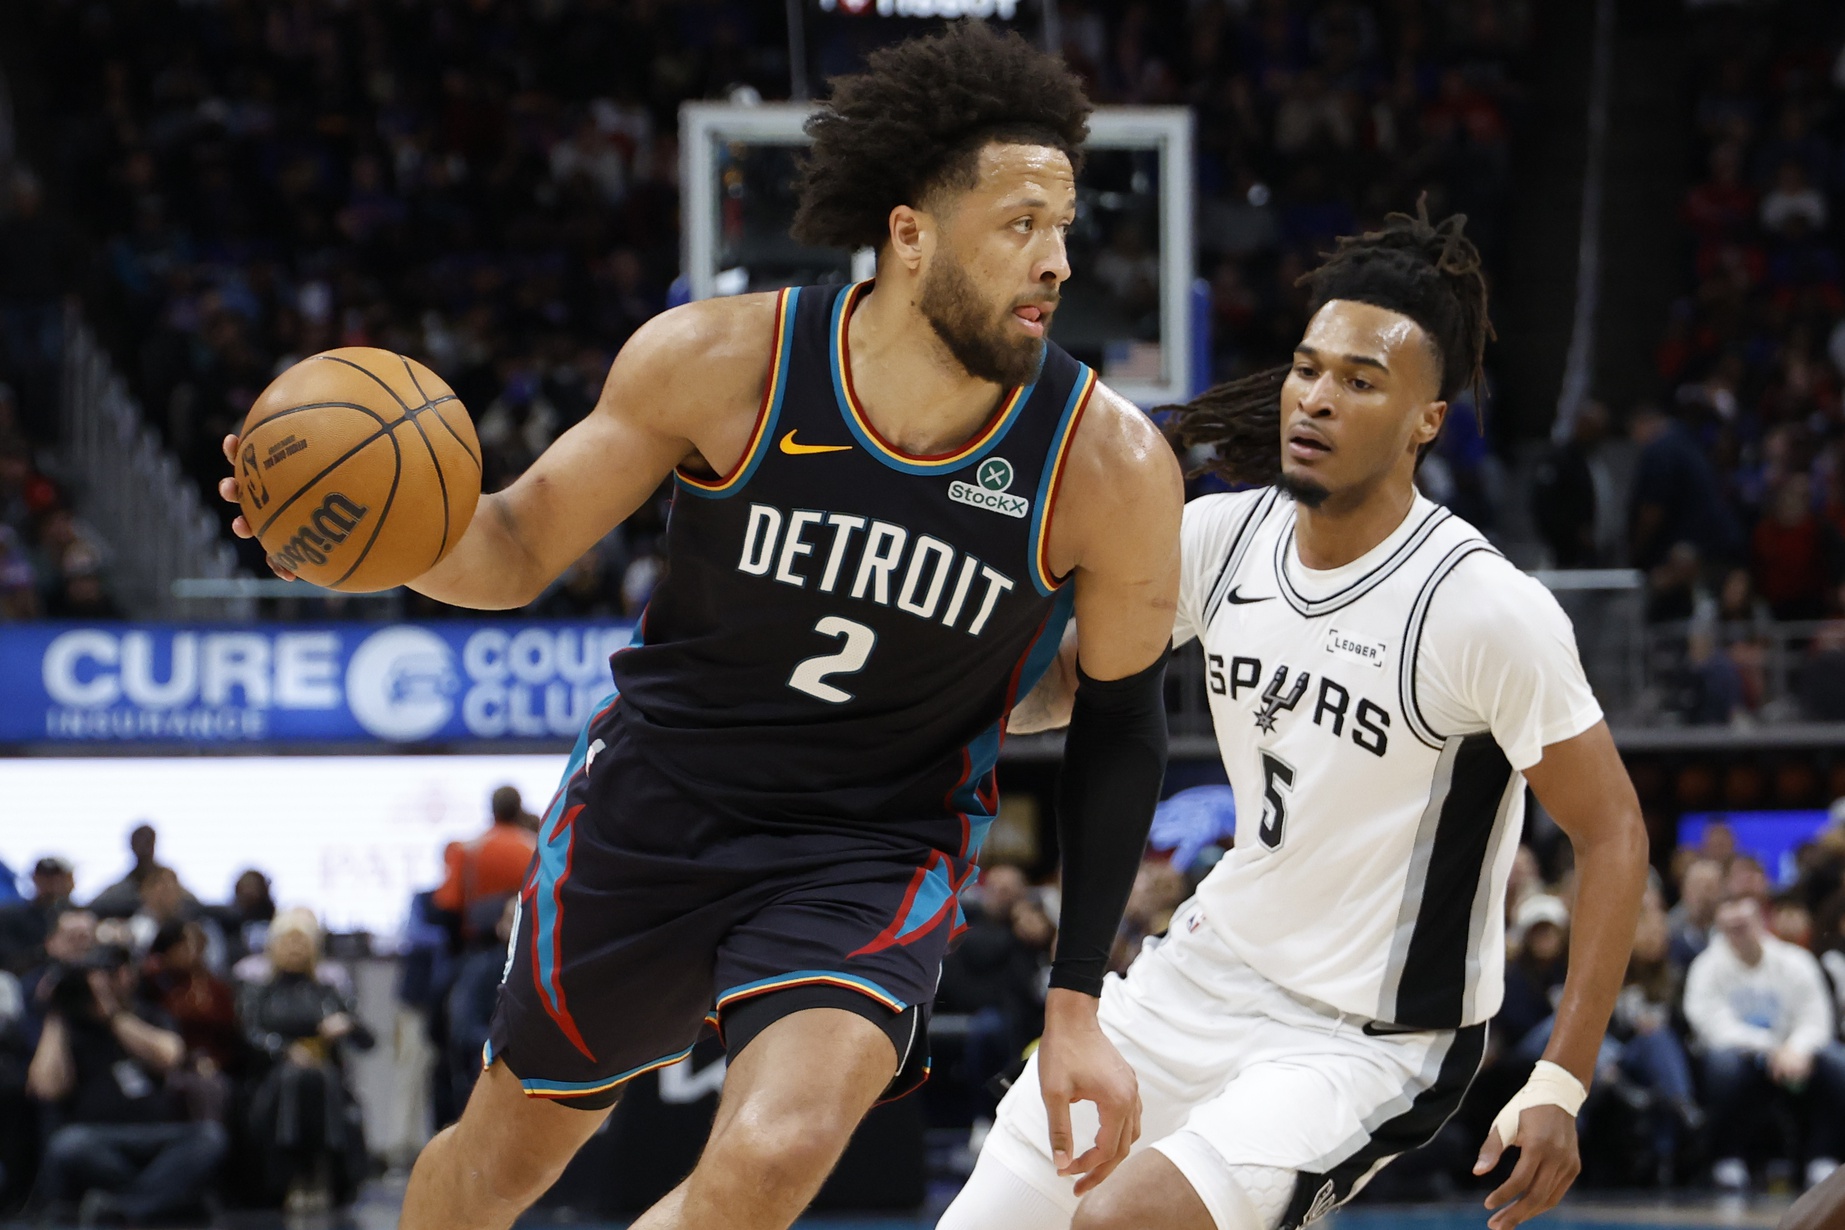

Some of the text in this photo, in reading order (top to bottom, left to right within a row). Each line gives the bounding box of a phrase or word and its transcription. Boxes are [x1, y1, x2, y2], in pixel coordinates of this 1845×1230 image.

[950, 484, 1026, 515] StockX
[738, 502, 1016, 637] DETROIT
[41, 629, 343, 709] CURE
[784, 615, 879, 705] 2
[1334, 637, 1377, 659] LEDGER
[1208, 654, 1391, 757] SPURS
[1257, 748, 1297, 853] 5
